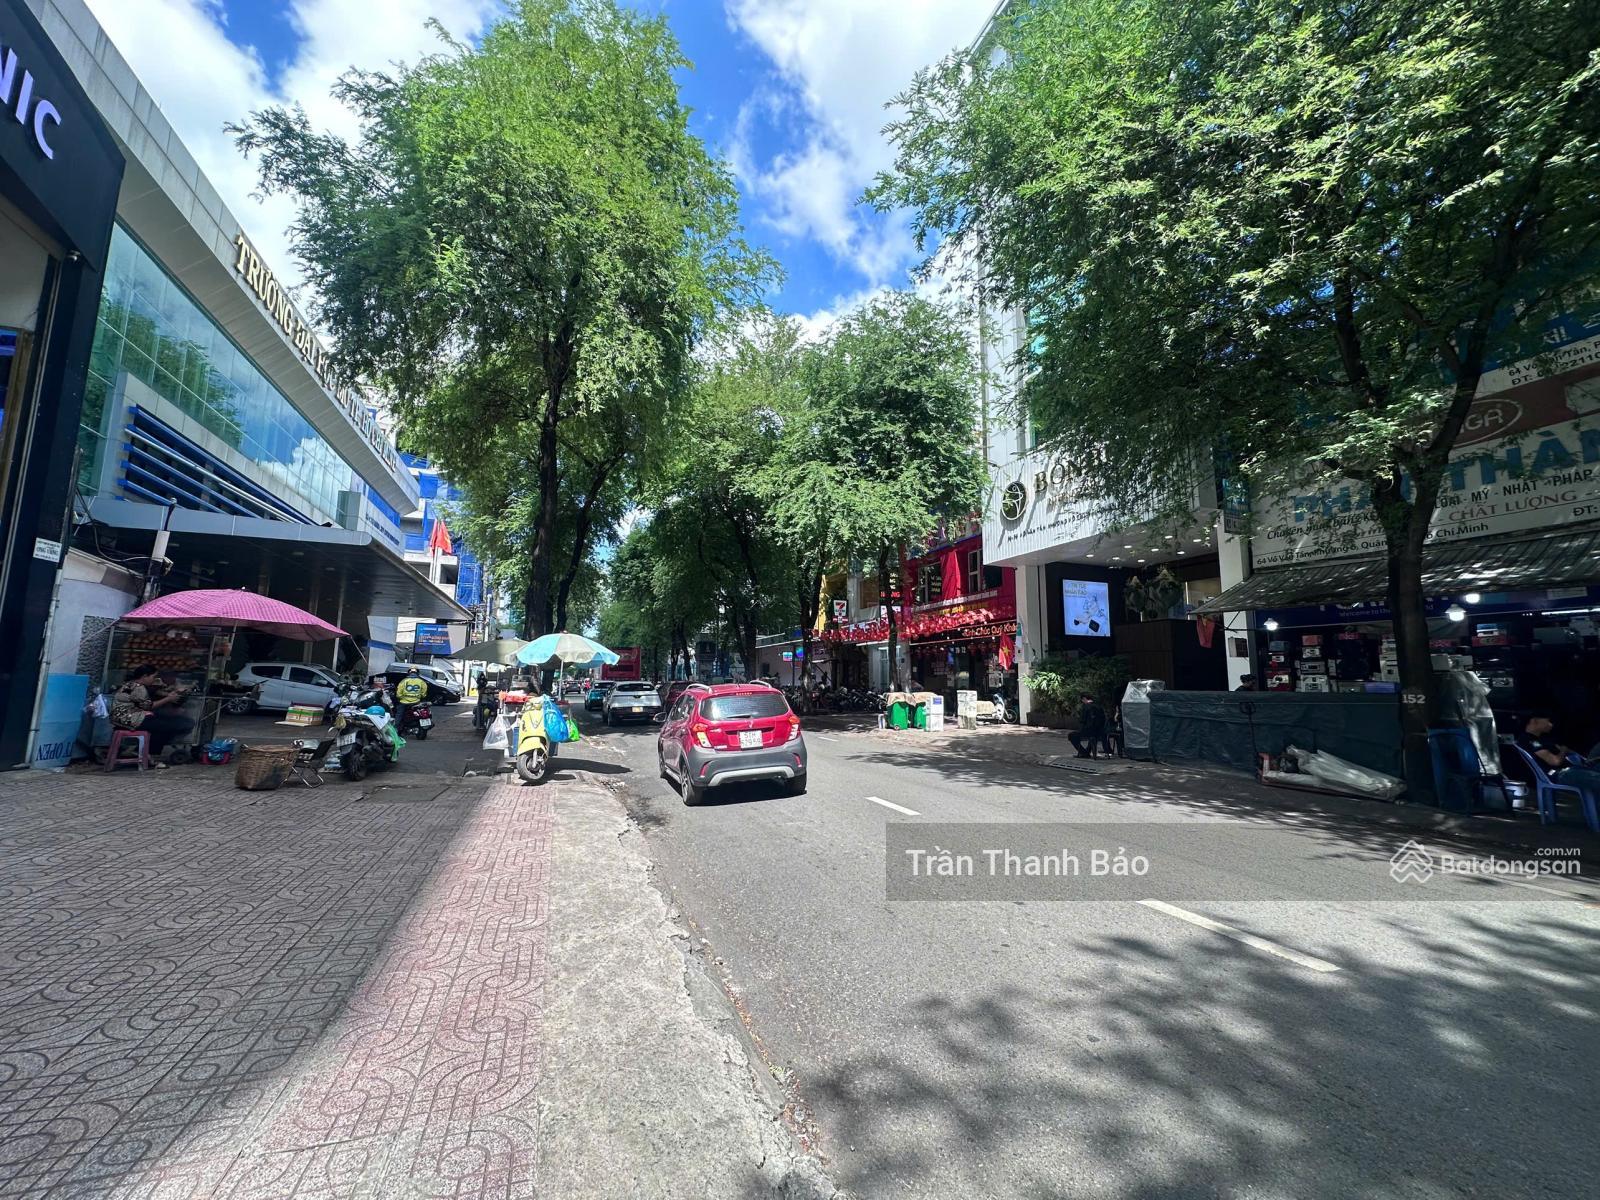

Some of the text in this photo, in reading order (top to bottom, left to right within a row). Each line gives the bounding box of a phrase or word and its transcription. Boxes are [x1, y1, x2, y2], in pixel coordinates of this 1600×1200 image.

[405, 682, 420, 693] be
[1402, 693, 1426, 705] 152
[35, 742, 63, 761] OPEN
